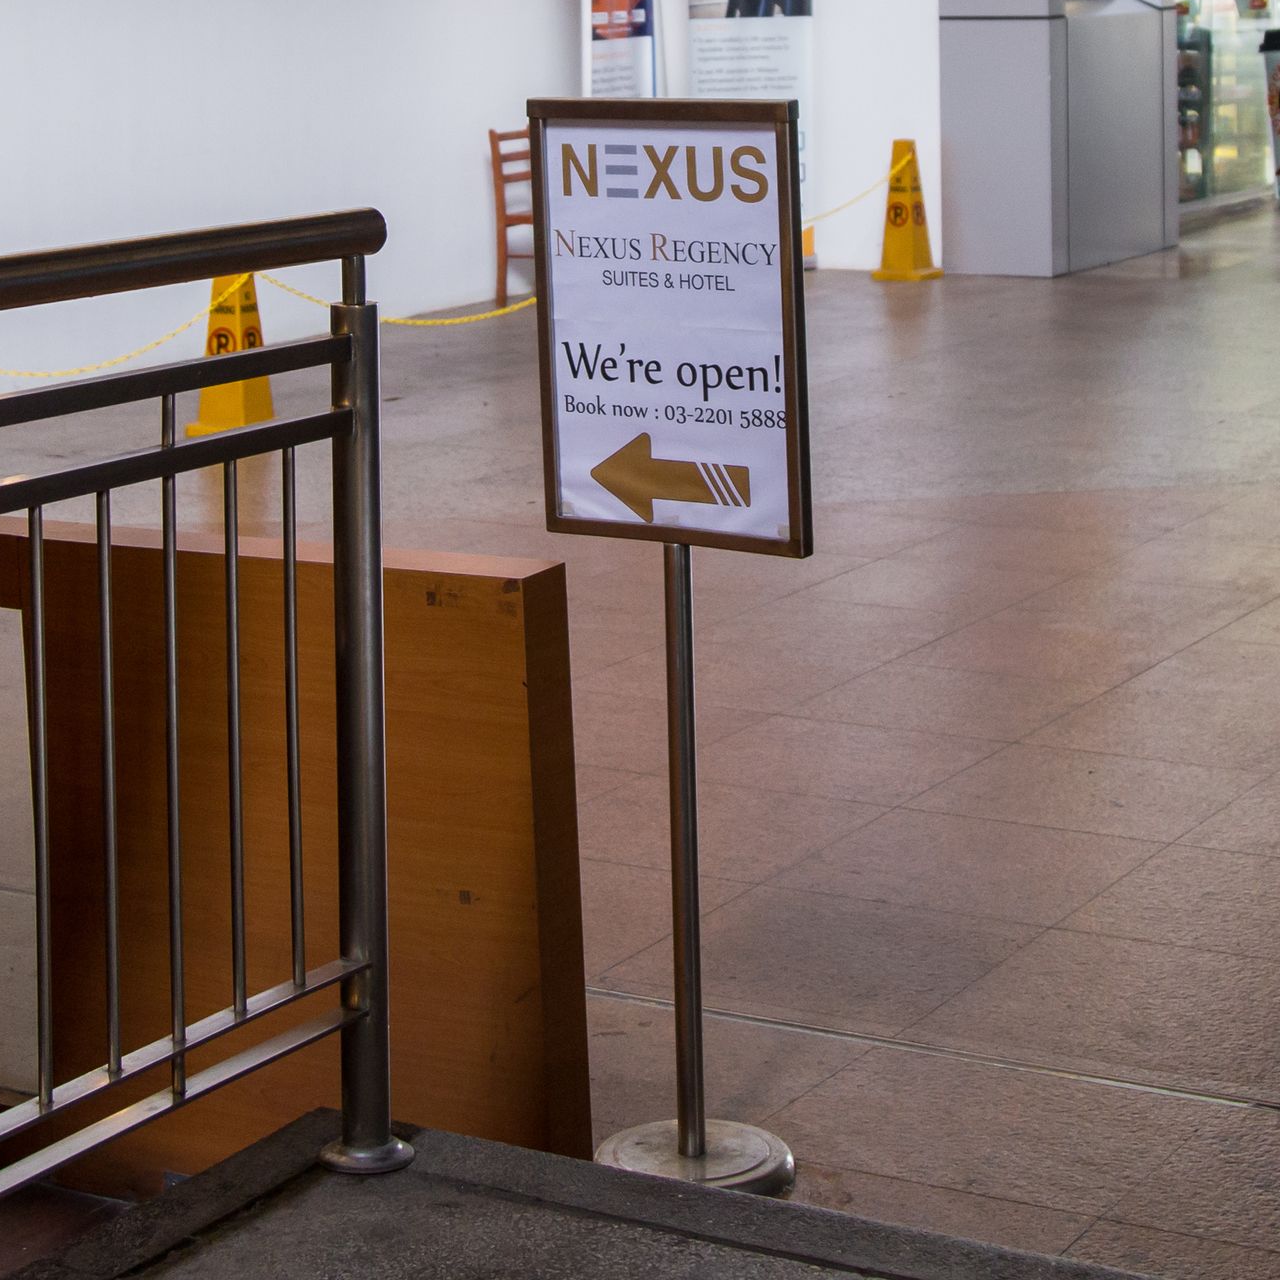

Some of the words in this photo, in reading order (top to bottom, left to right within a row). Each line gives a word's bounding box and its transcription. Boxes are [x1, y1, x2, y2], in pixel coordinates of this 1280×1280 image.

[561, 143, 769, 203] NEXUS
[553, 229, 642, 261] NEXUS
[649, 233, 778, 266] REGENCY
[602, 269, 660, 288] SUITES
[663, 273, 675, 289] &
[679, 273, 735, 291] HOTEL
[561, 341, 663, 385] We're
[676, 355, 782, 402] open!
[564, 394, 607, 415] Book
[612, 404, 649, 419] now
[664, 405, 733, 426] 03-2201
[740, 409, 787, 429] 5888
